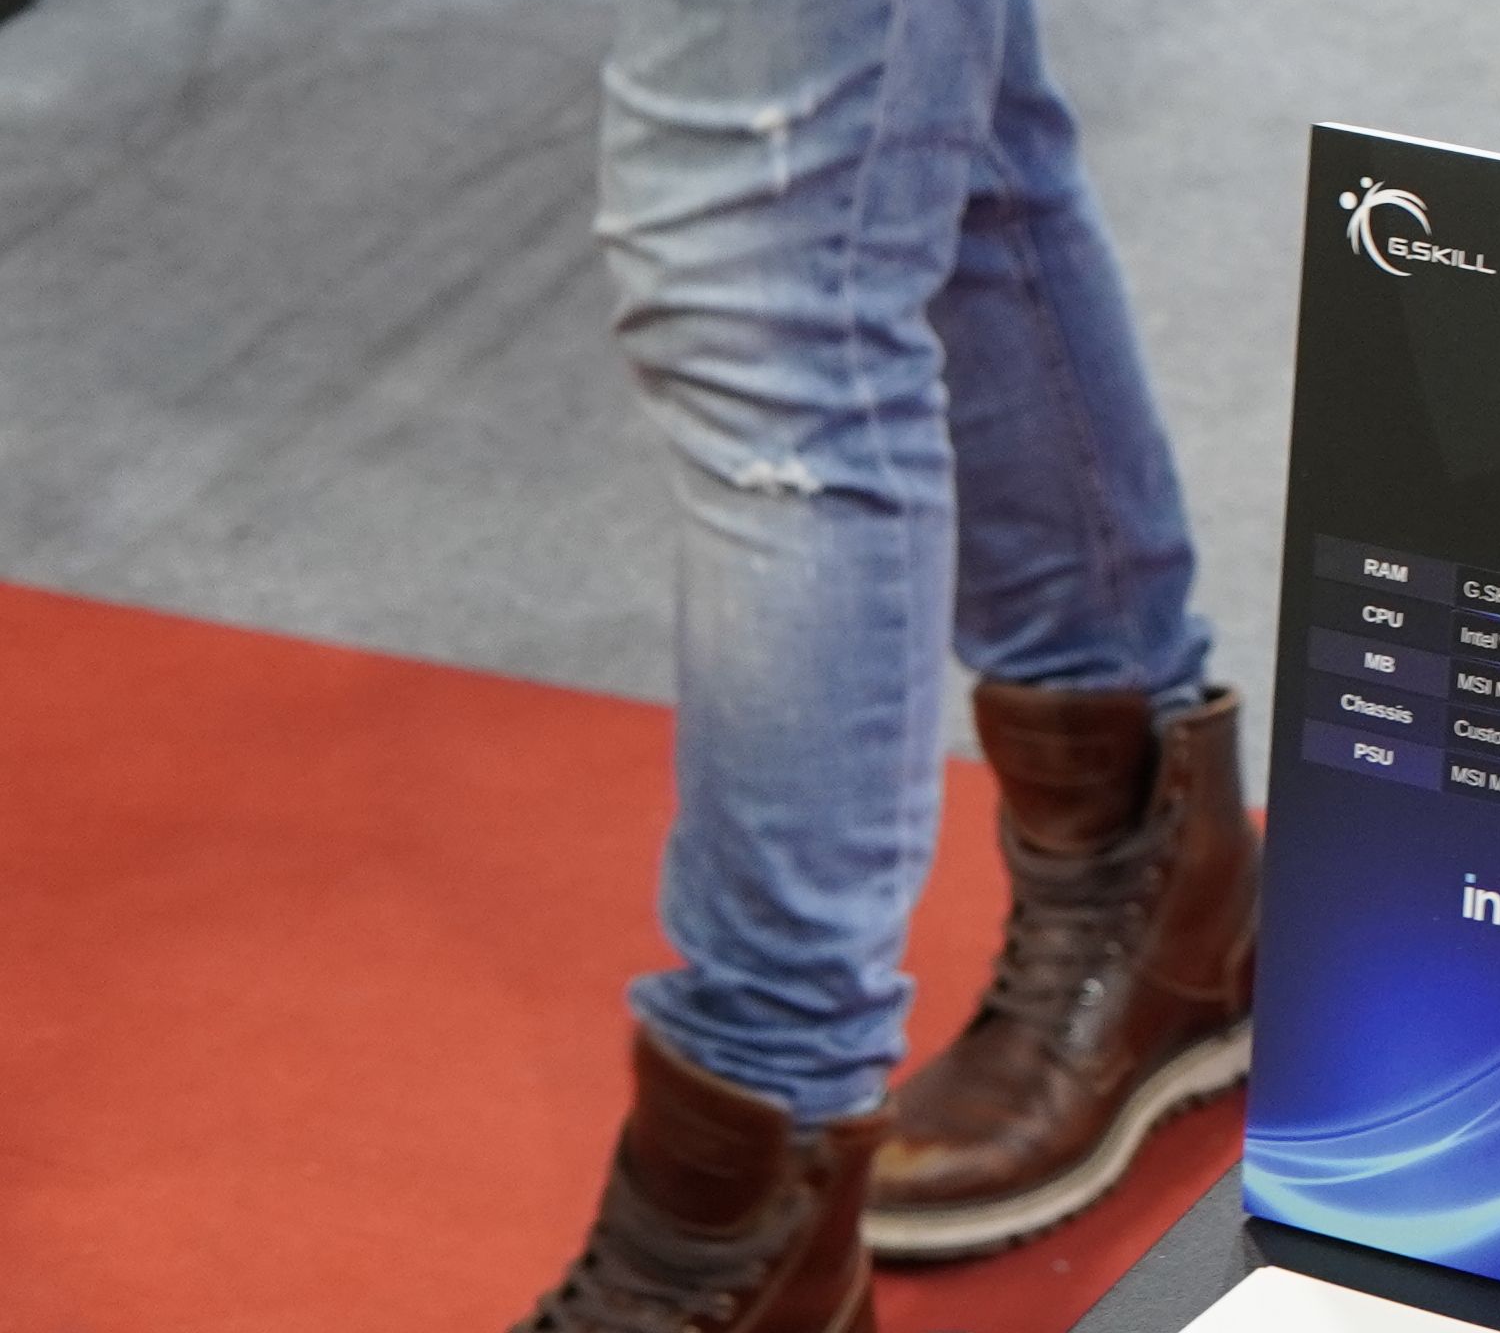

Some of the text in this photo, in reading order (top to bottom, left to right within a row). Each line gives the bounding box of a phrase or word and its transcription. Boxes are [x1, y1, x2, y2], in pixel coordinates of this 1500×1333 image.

[1387, 236, 1497, 275] G.SKILL
[1363, 558, 1409, 583] RAM
[1362, 605, 1404, 629] CPU
[1364, 652, 1397, 674] MB
[1457, 672, 1493, 696] MSI
[1340, 693, 1414, 724] Chassis
[1353, 742, 1395, 767] PSU
[1450, 765, 1487, 788] MSI
